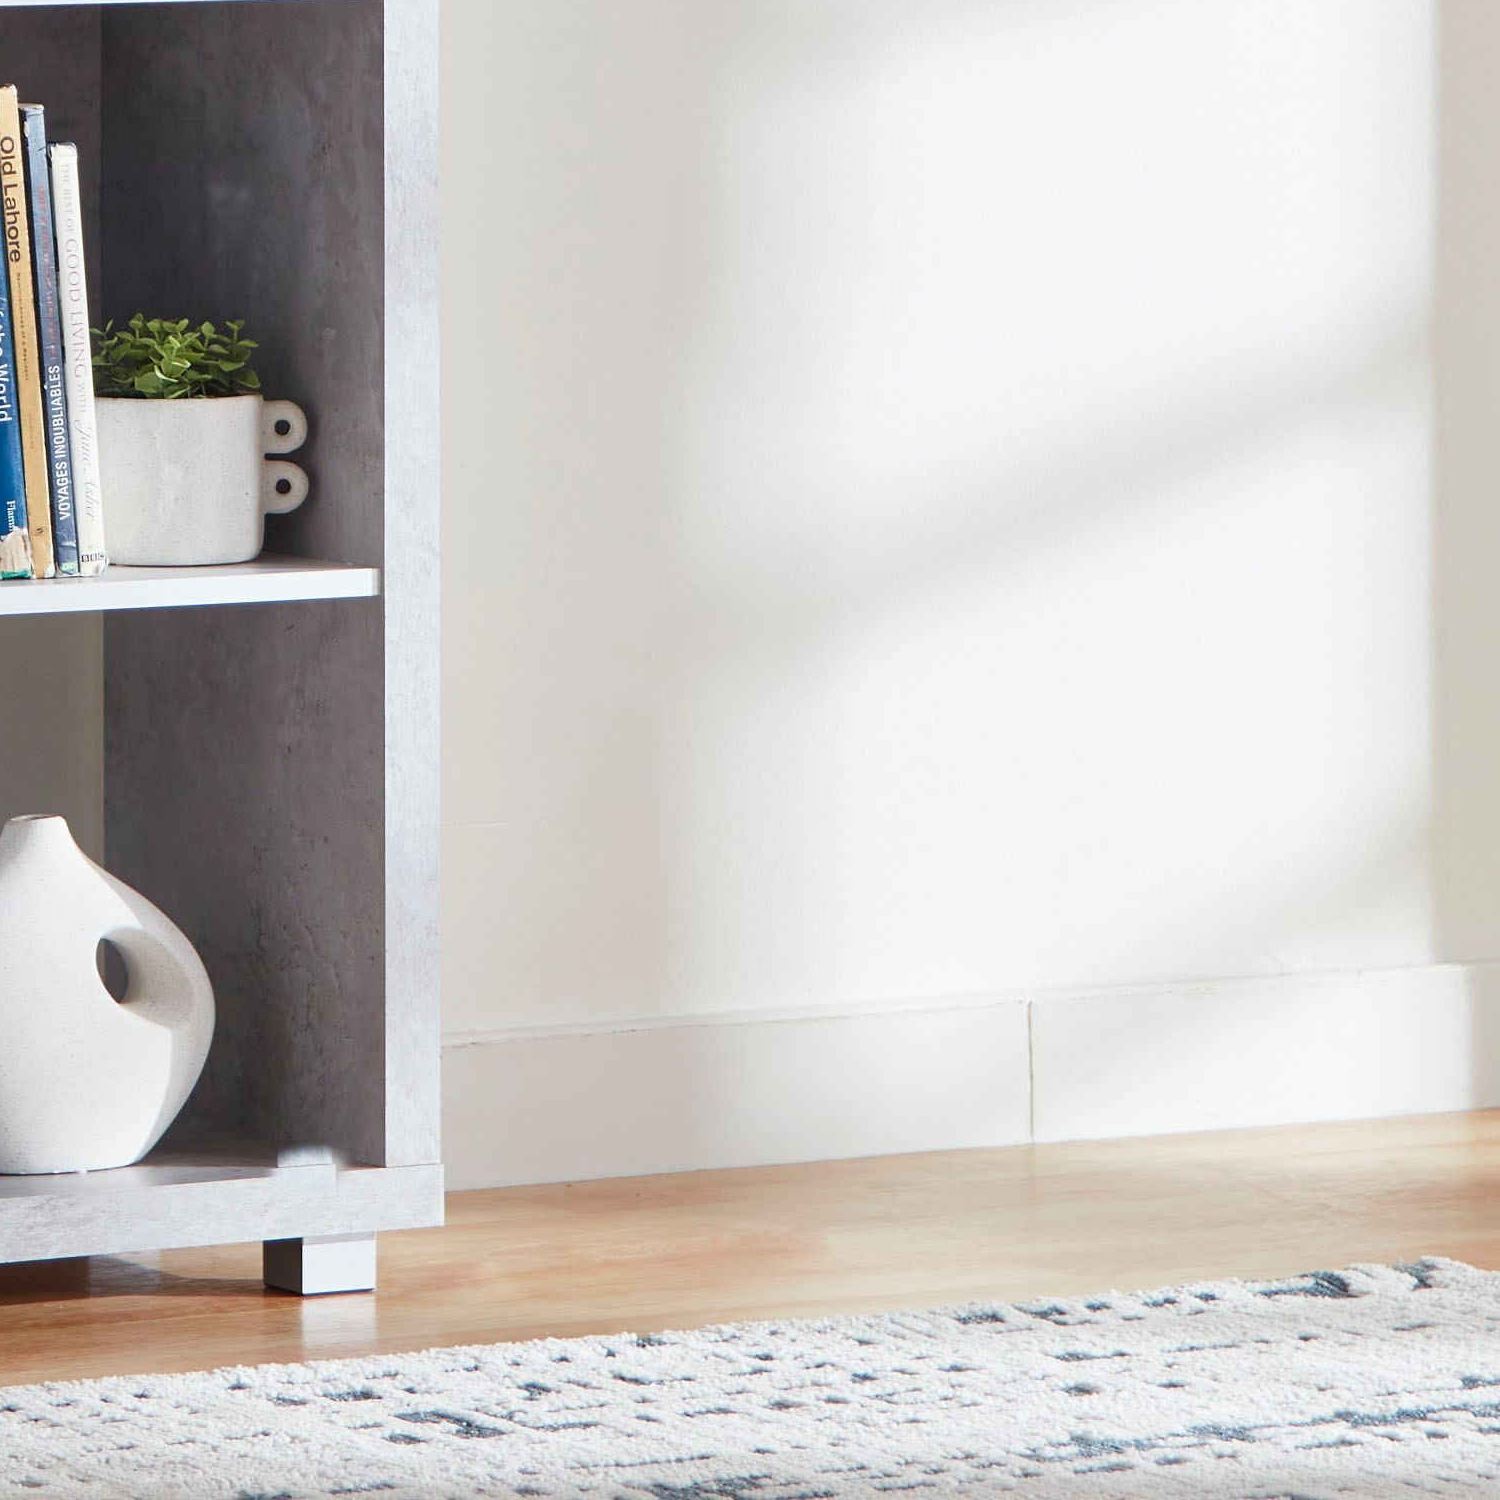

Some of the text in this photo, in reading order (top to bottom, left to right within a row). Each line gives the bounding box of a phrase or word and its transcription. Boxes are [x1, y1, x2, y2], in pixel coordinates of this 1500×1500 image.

[0, 136, 23, 263] Old Lahore
[60, 164, 88, 413] THE BEST OF GOOD LIVING WITH
[48, 365, 68, 458] INOUBLIABLES
[73, 419, 95, 466] Jane
[54, 462, 69, 520] VOYAGES
